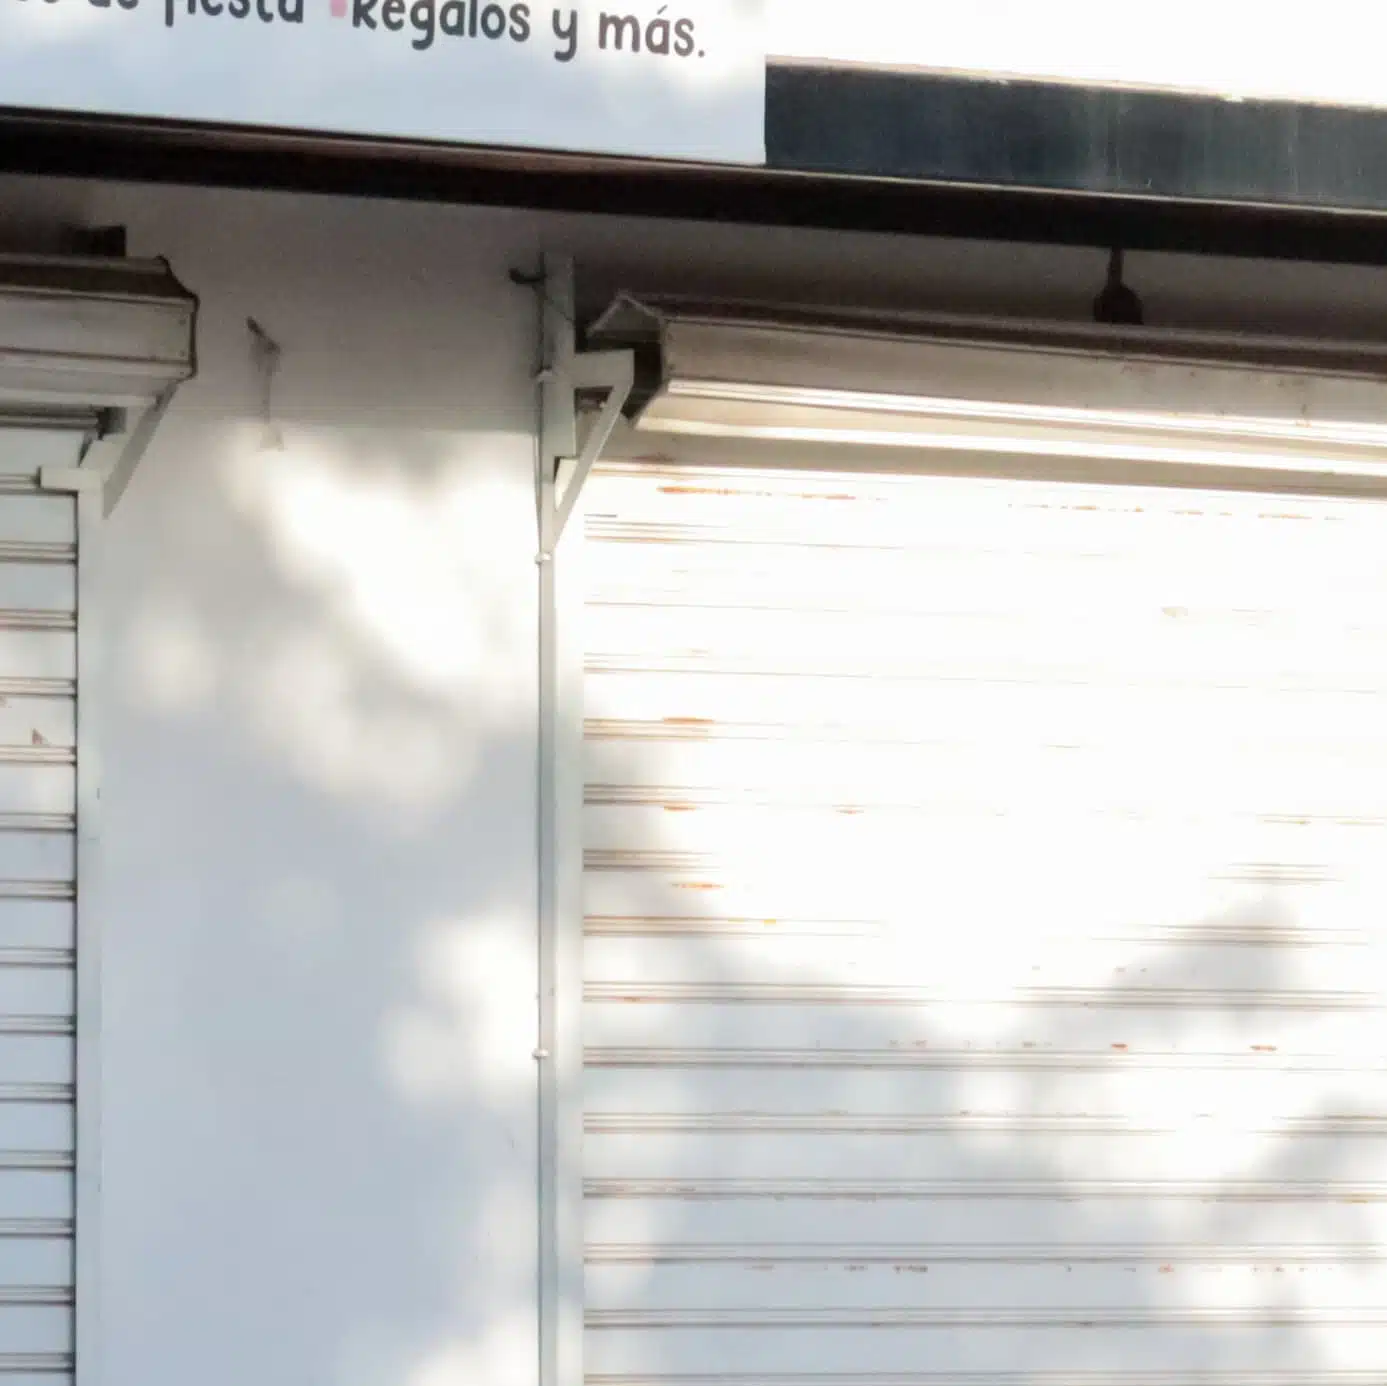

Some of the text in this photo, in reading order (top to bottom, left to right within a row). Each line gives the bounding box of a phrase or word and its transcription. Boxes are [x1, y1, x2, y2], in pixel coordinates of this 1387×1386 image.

[352, 0, 530, 51] Regalos
[552, 8, 577, 62] y
[598, 5, 705, 58] más.
